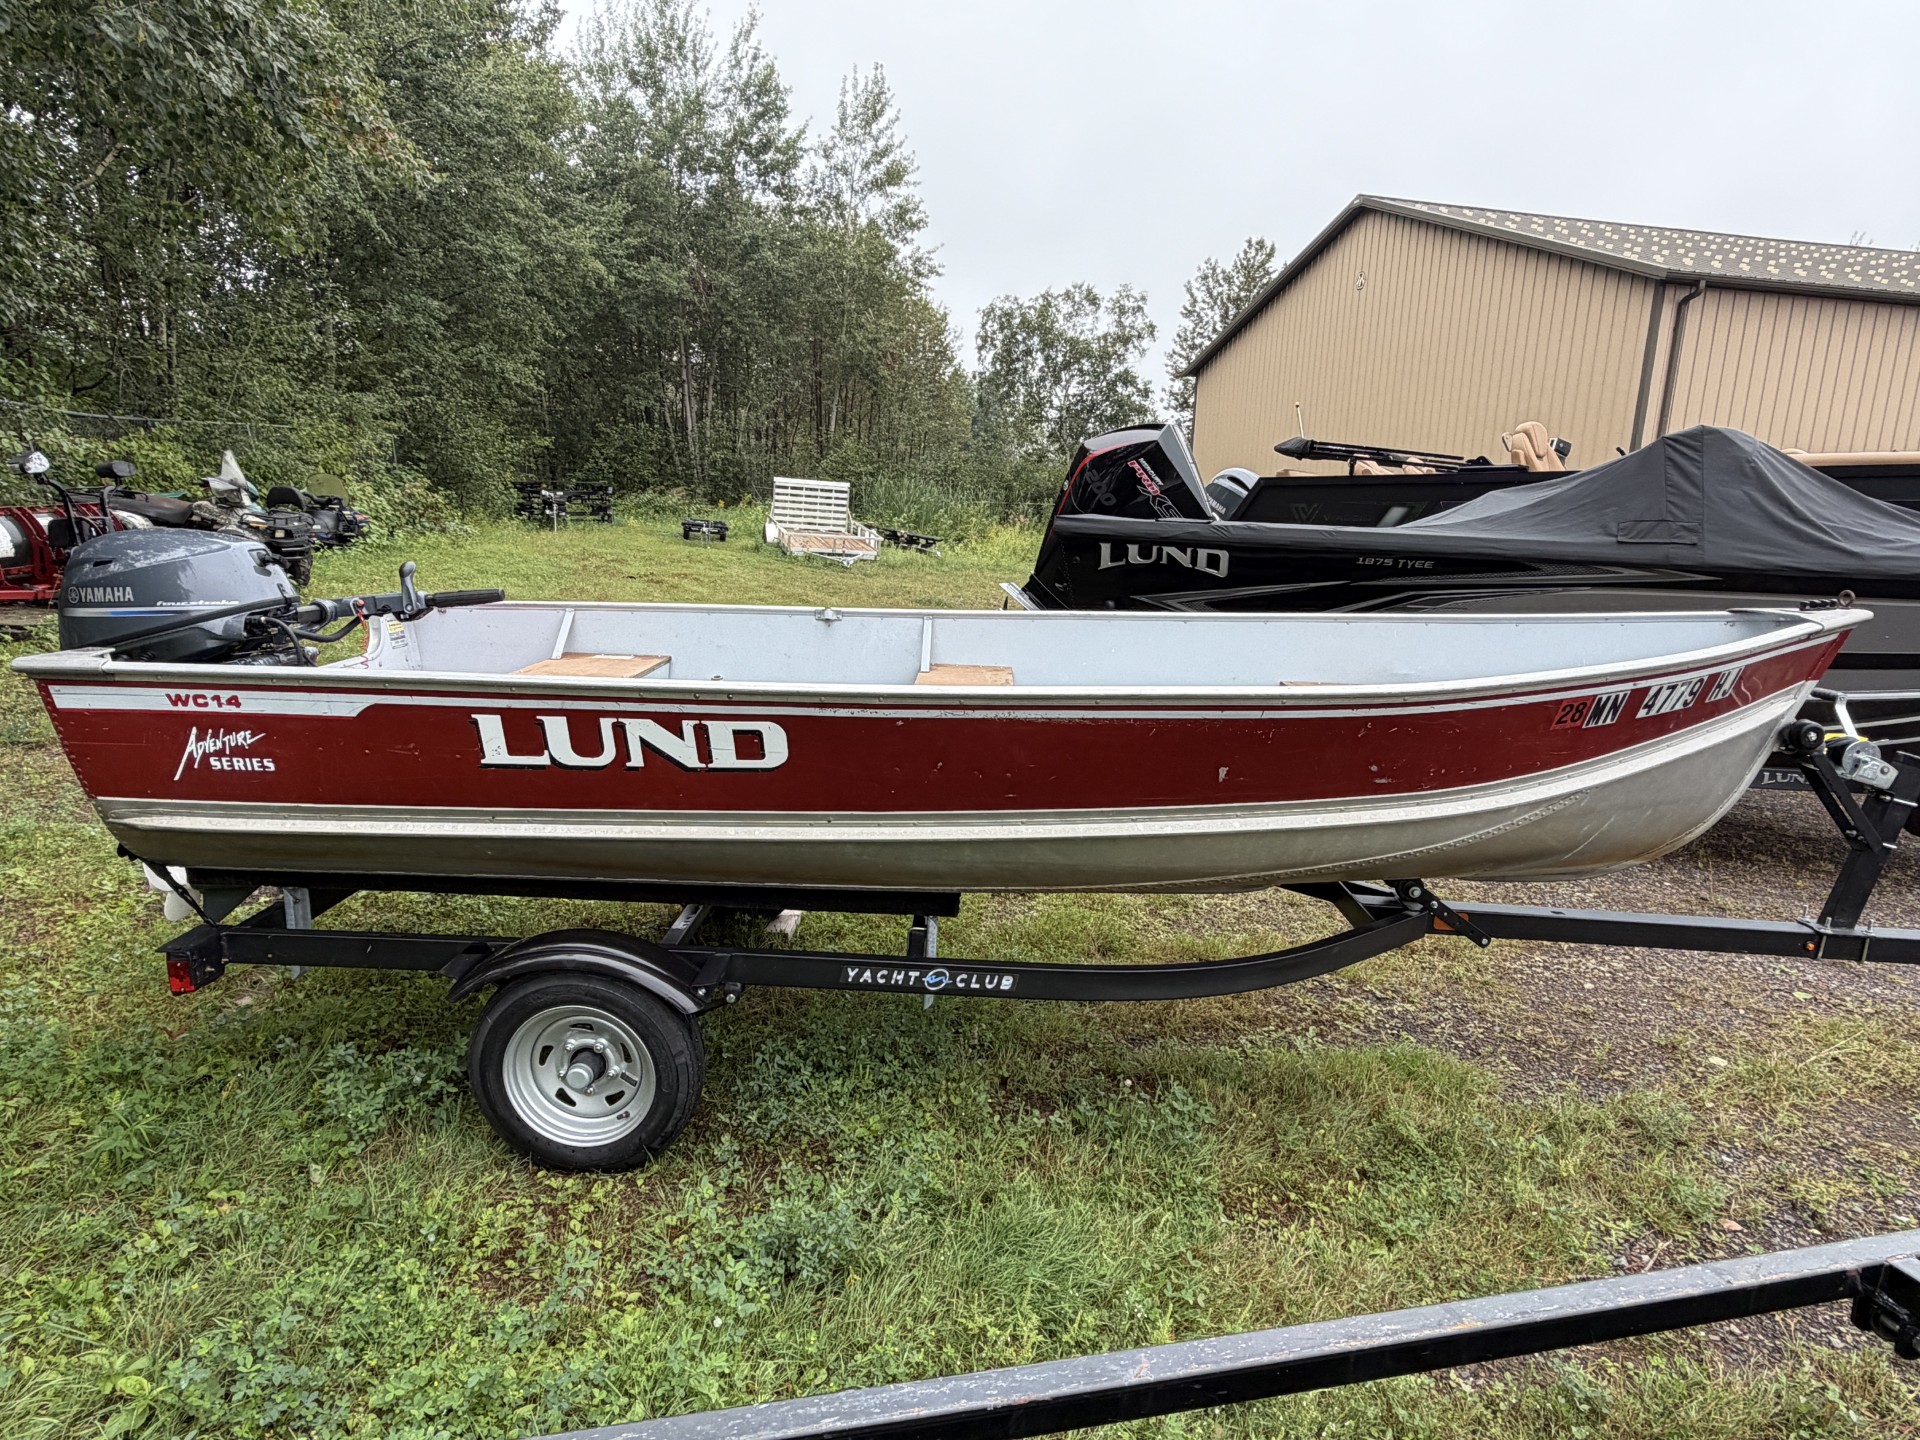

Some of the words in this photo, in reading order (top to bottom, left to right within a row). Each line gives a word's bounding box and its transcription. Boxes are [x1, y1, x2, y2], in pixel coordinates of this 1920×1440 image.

[1127, 459, 1161, 496] PRO
[1138, 457, 1165, 486] MERCURY
[1085, 468, 1117, 506] 200
[1097, 542, 1230, 578] LUND
[1355, 556, 1394, 567] 1875
[1397, 559, 1435, 569] TYEE
[78, 586, 135, 603] YAMAHA
[165, 693, 242, 709] WC14
[1554, 702, 1588, 726] 28
[1585, 692, 1628, 727] MN
[1641, 678, 1705, 717] 4779
[1711, 668, 1743, 699] HJ
[470, 713, 790, 772] LUND
[209, 756, 276, 772] SERIES
[1760, 771, 1811, 785] LUN
[847, 967, 921, 986] YACHT
[955, 973, 1015, 990] CLUB
